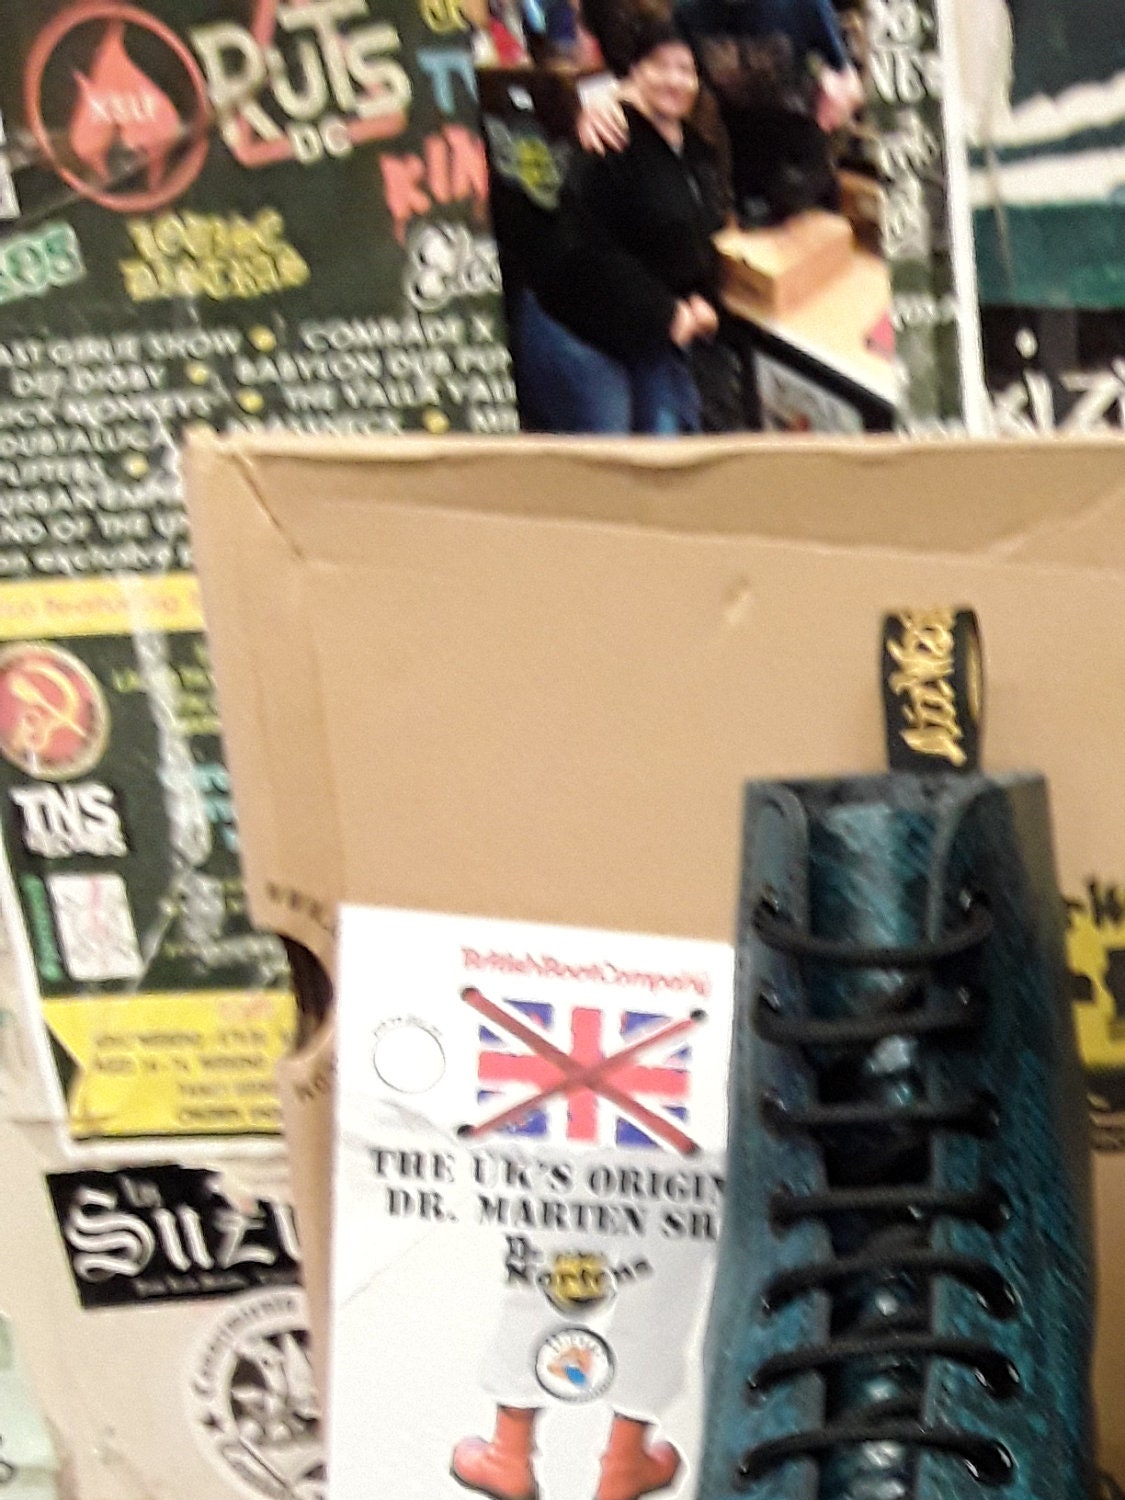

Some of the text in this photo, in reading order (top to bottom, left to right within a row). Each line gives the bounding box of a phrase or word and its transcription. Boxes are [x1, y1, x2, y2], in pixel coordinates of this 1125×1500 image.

[368, 1148, 455, 1184] THE
[385, 1184, 460, 1226] DR.
[476, 1193, 646, 1238] MARTEN
